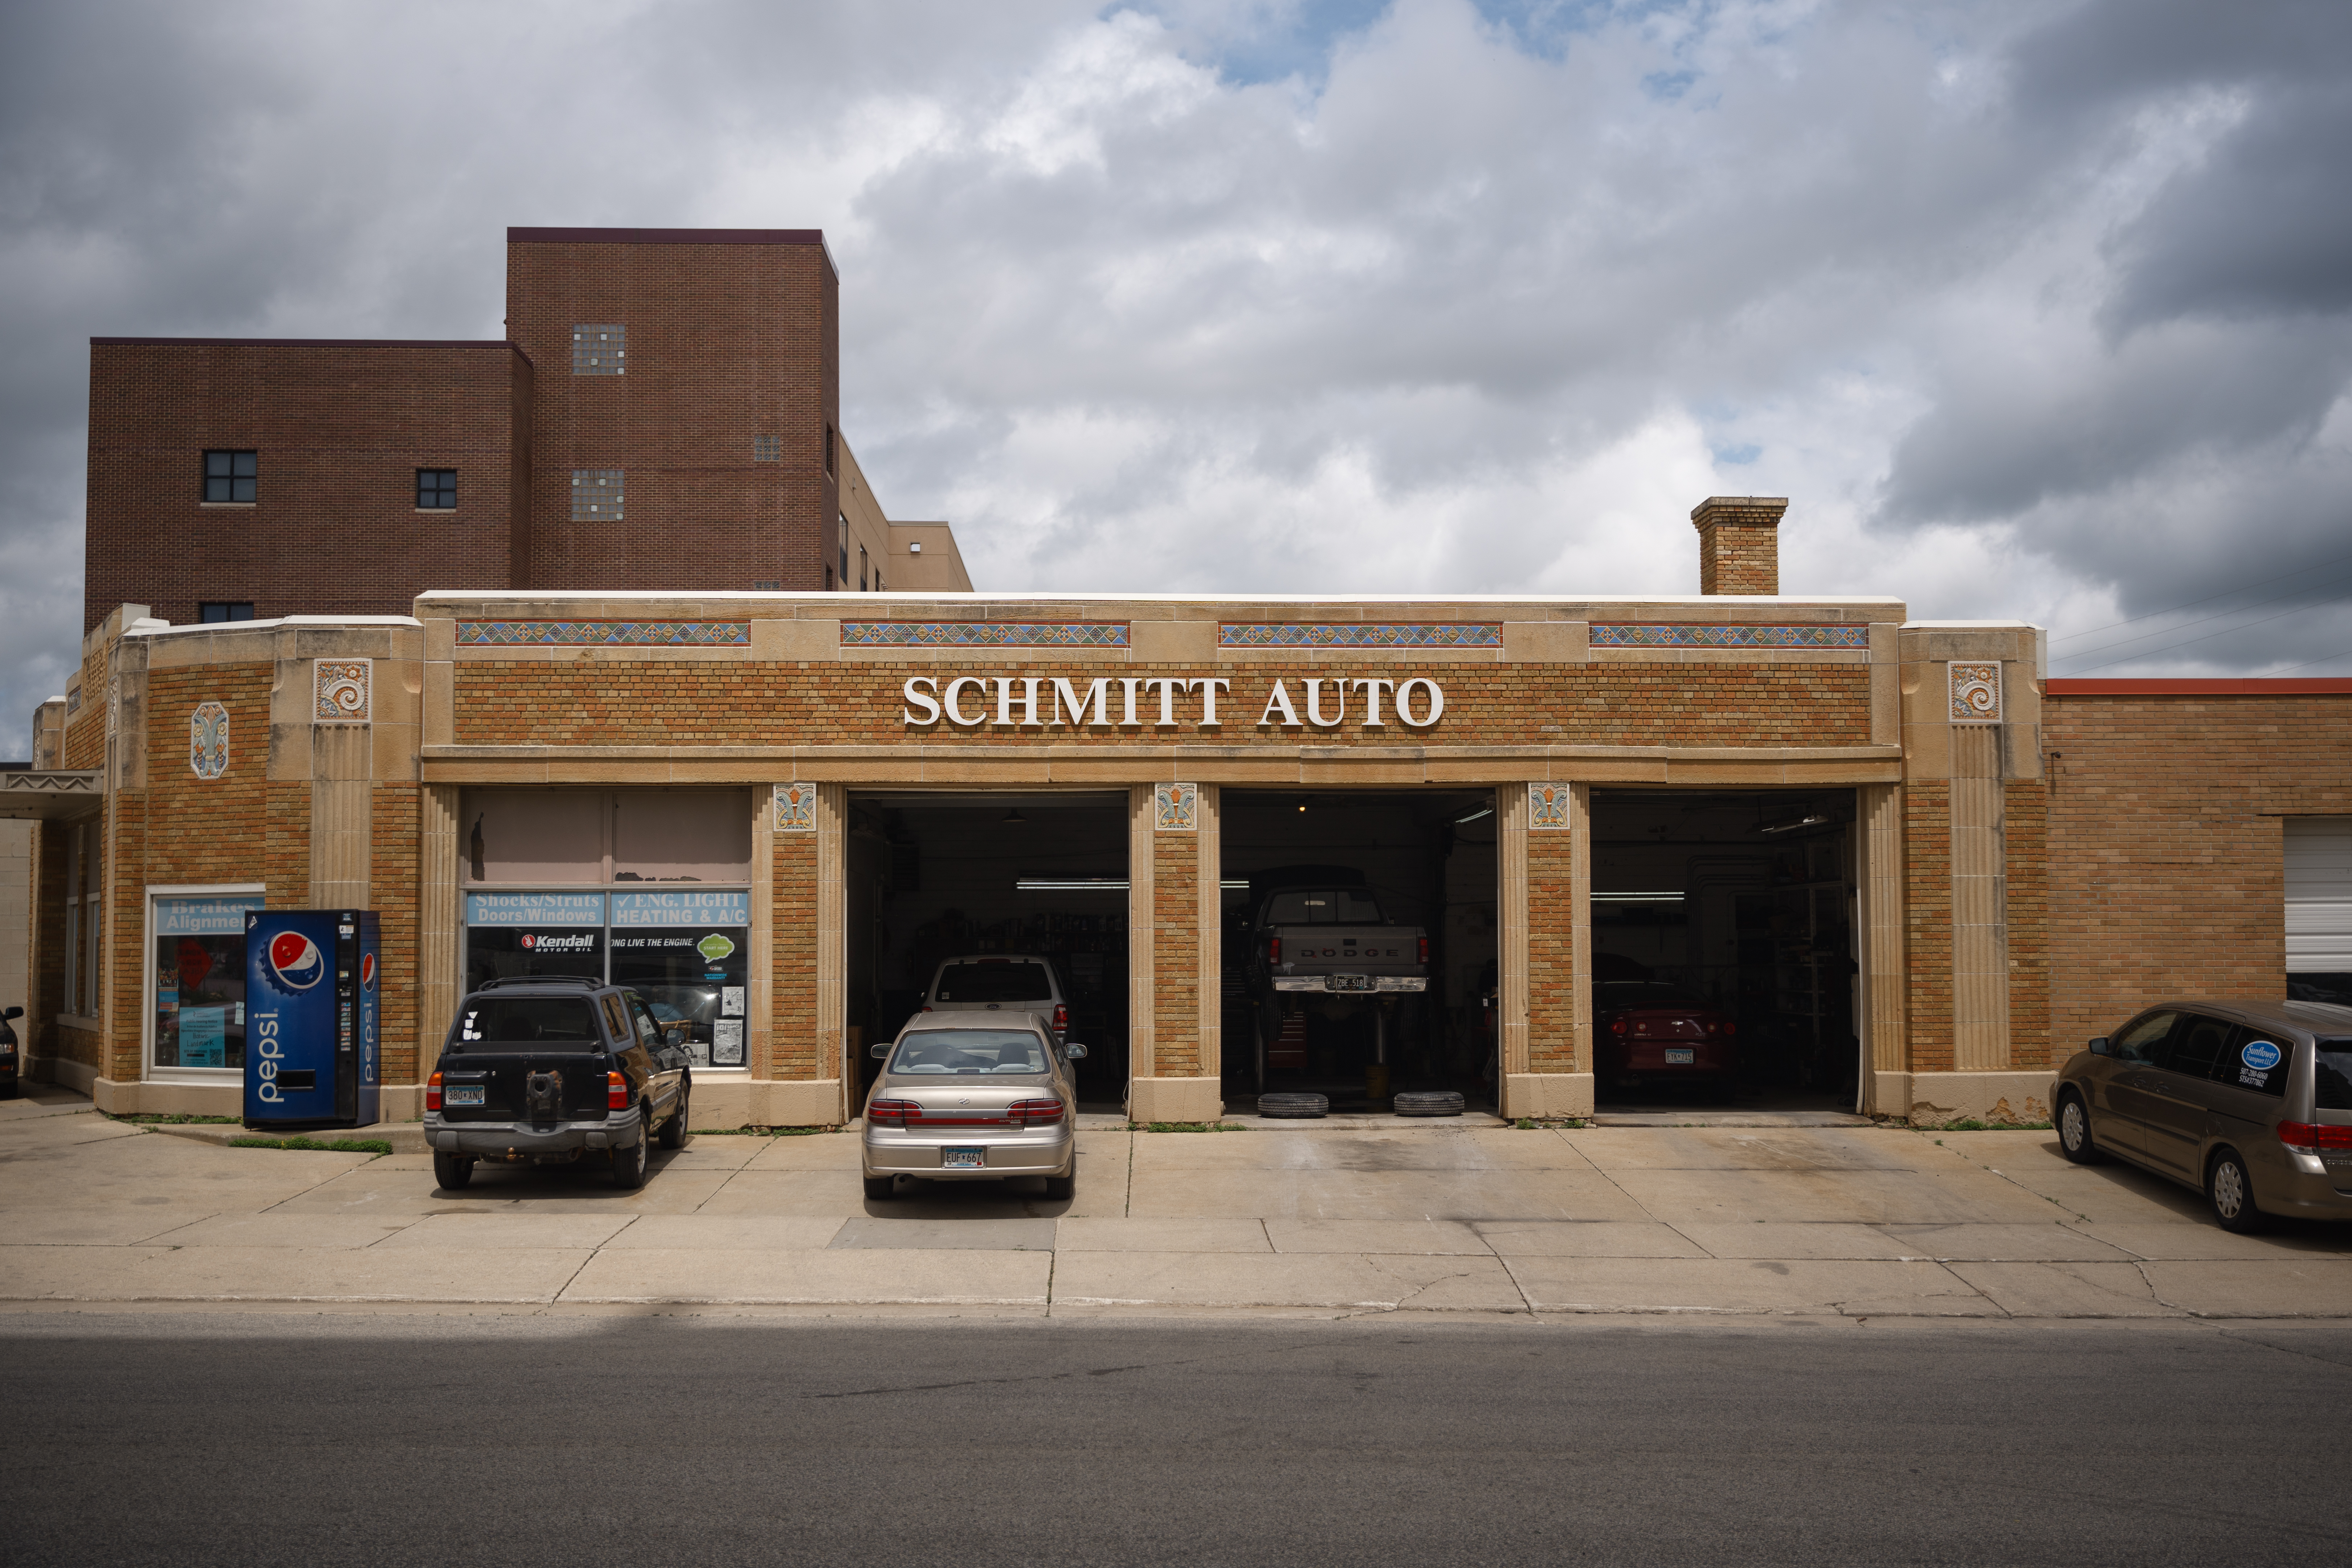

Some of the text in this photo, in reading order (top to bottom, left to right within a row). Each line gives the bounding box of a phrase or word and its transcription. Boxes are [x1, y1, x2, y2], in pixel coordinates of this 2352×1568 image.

[904, 677, 1444, 727] SCHMITT AUTO
[171, 899, 255, 914] Brakes
[476, 893, 599, 907] Shocks/Struts
[634, 893, 742, 907] ENG. LIGHT
[478, 908, 596, 922] Doors/Windows
[617, 909, 745, 923] HEATING & A/C
[536, 934, 594, 947] Kendall
[1301, 949, 1398, 957] DODGE
[364, 1003, 373, 1082] pepsi
[254, 1013, 285, 1102] pepsi
[2247, 1045, 2277, 1059] Sunflower
[2246, 1054, 2265, 1065] Transport
[2240, 1067, 2268, 1080] 507-280-6060
[2239, 1075, 2264, 1087] STS#377862
[449, 1090, 482, 1100] 380 XND
[947, 1152, 981, 1162] EUF 667
